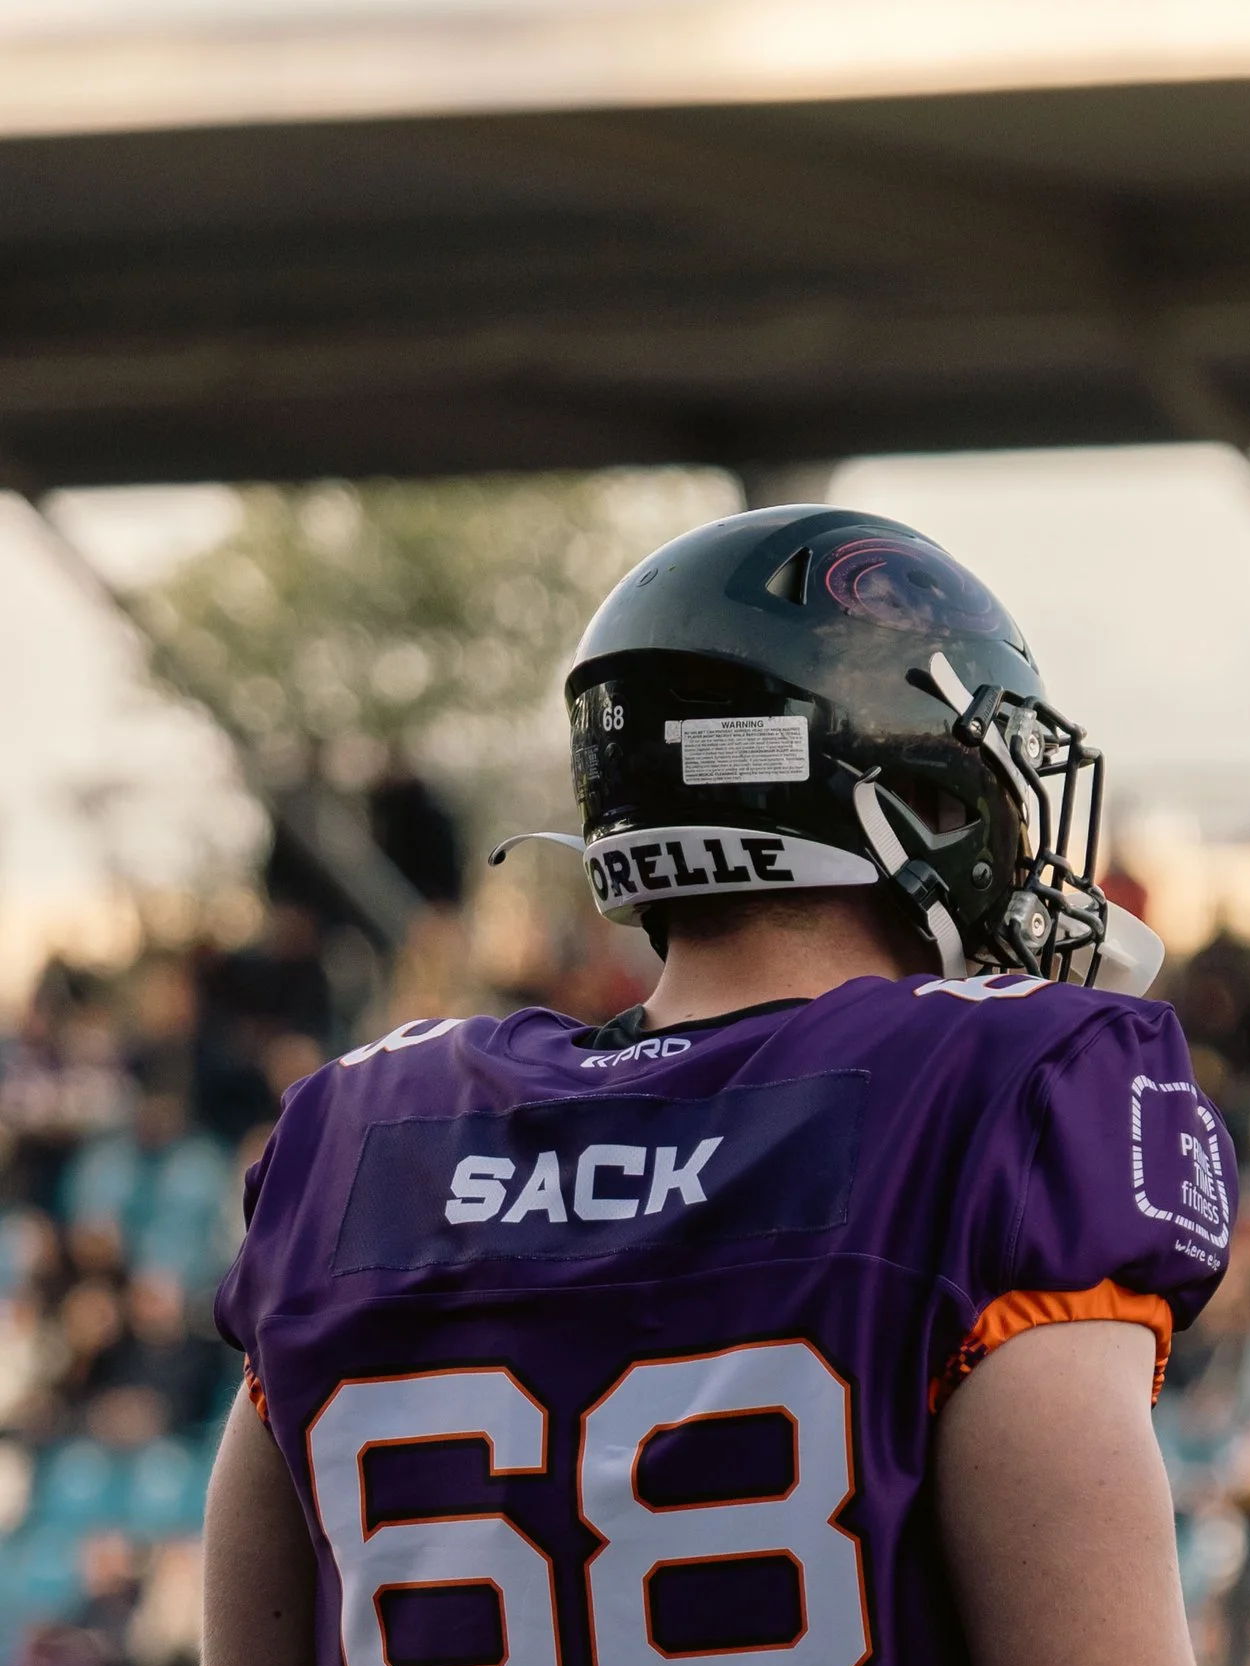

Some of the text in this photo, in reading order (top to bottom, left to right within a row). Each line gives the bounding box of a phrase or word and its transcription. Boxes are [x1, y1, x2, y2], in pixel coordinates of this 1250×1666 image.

[602, 705, 625, 731] 68
[721, 720, 765, 729] WARNING
[584, 837, 794, 902] ORELLE
[444, 1136, 724, 1225] SACK
[1193, 1161, 1218, 1200] TIME
[1181, 1181, 1220, 1225] fitness
[1175, 1239, 1206, 1262] where
